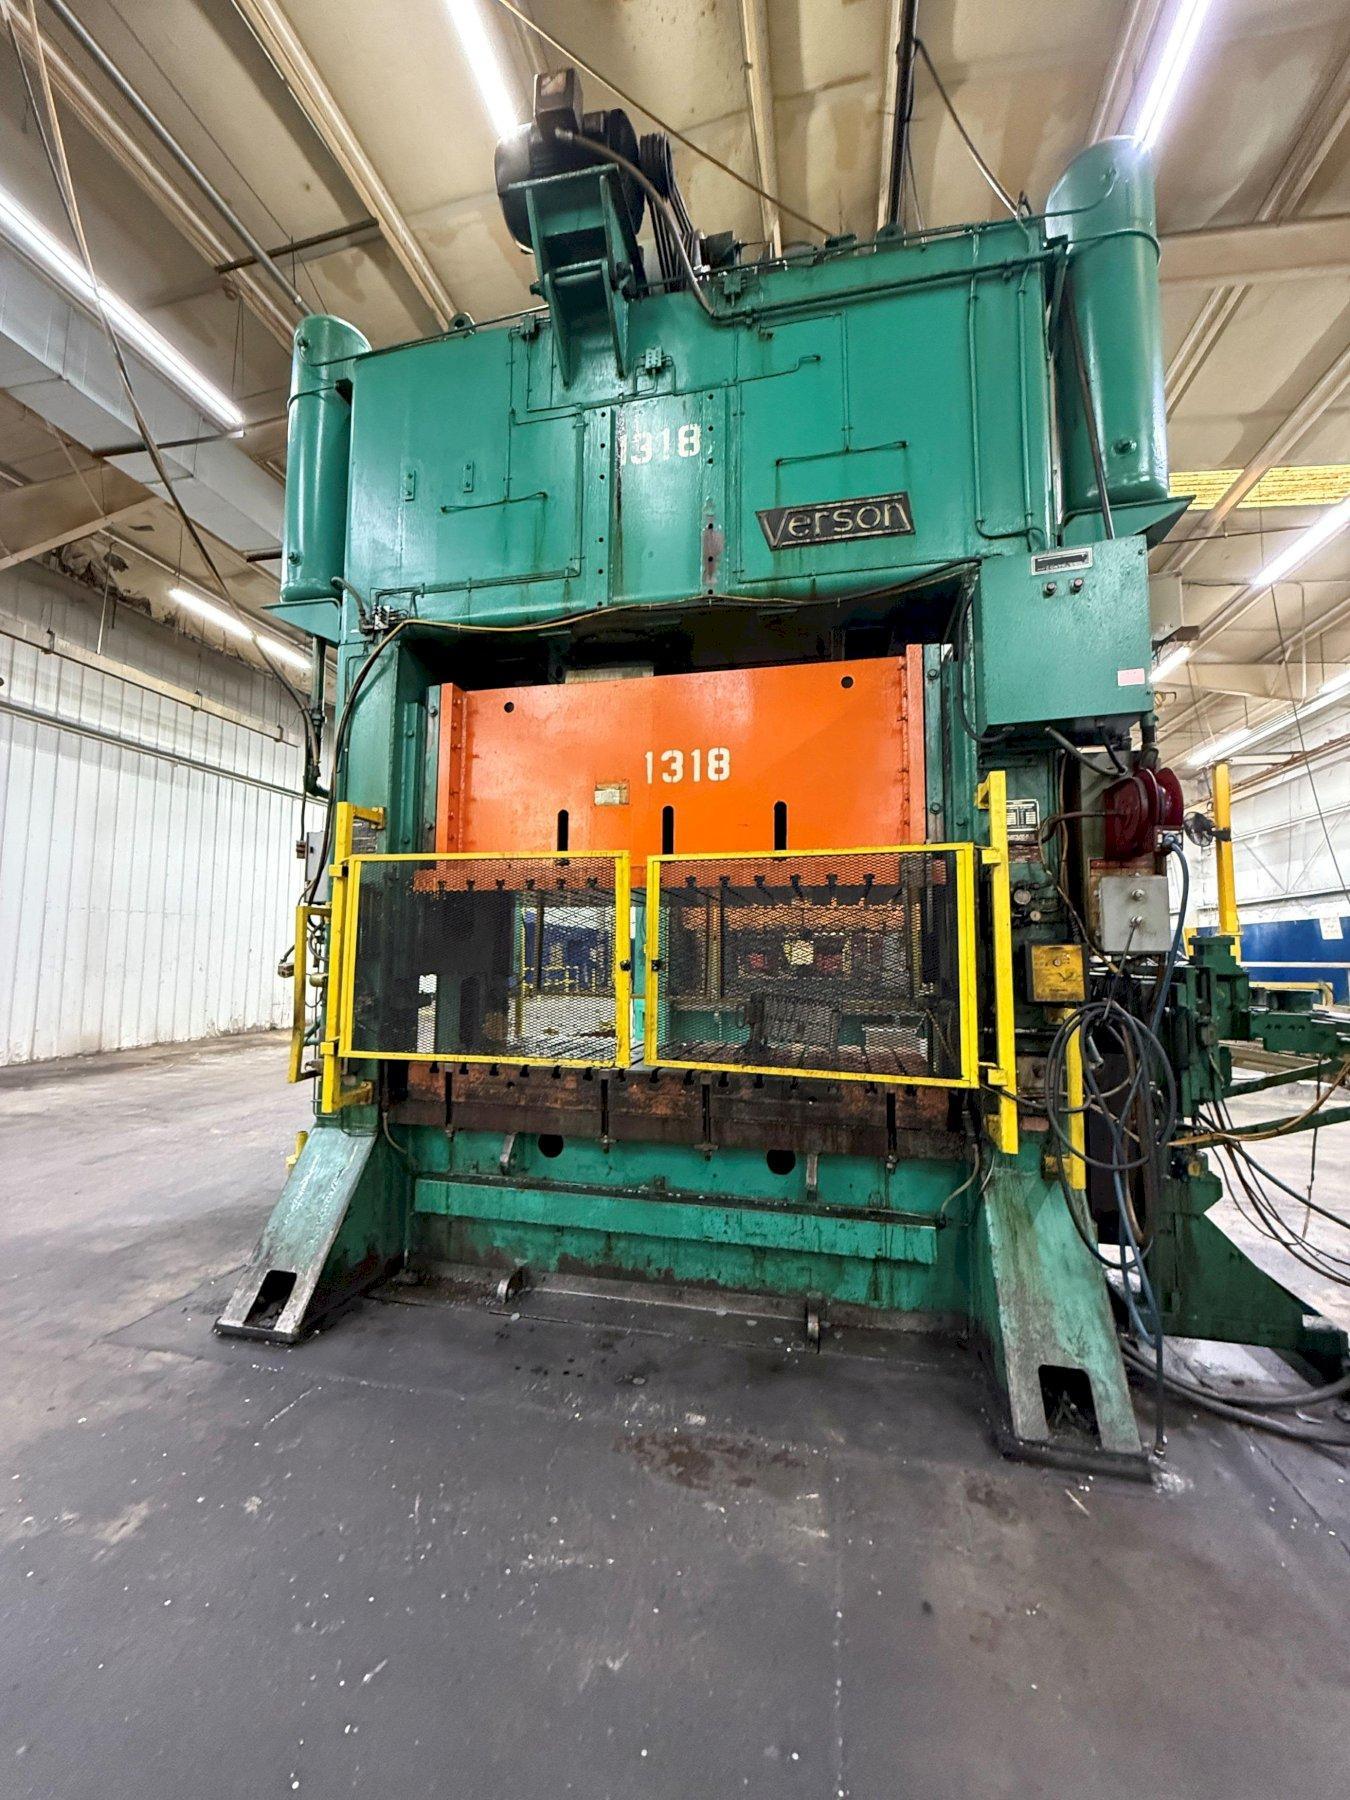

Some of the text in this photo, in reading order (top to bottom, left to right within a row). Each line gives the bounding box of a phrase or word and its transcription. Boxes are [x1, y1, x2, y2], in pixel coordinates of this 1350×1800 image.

[618, 423, 701, 465] 1318
[758, 502, 911, 548] Verson
[645, 747, 730, 784] 1318
